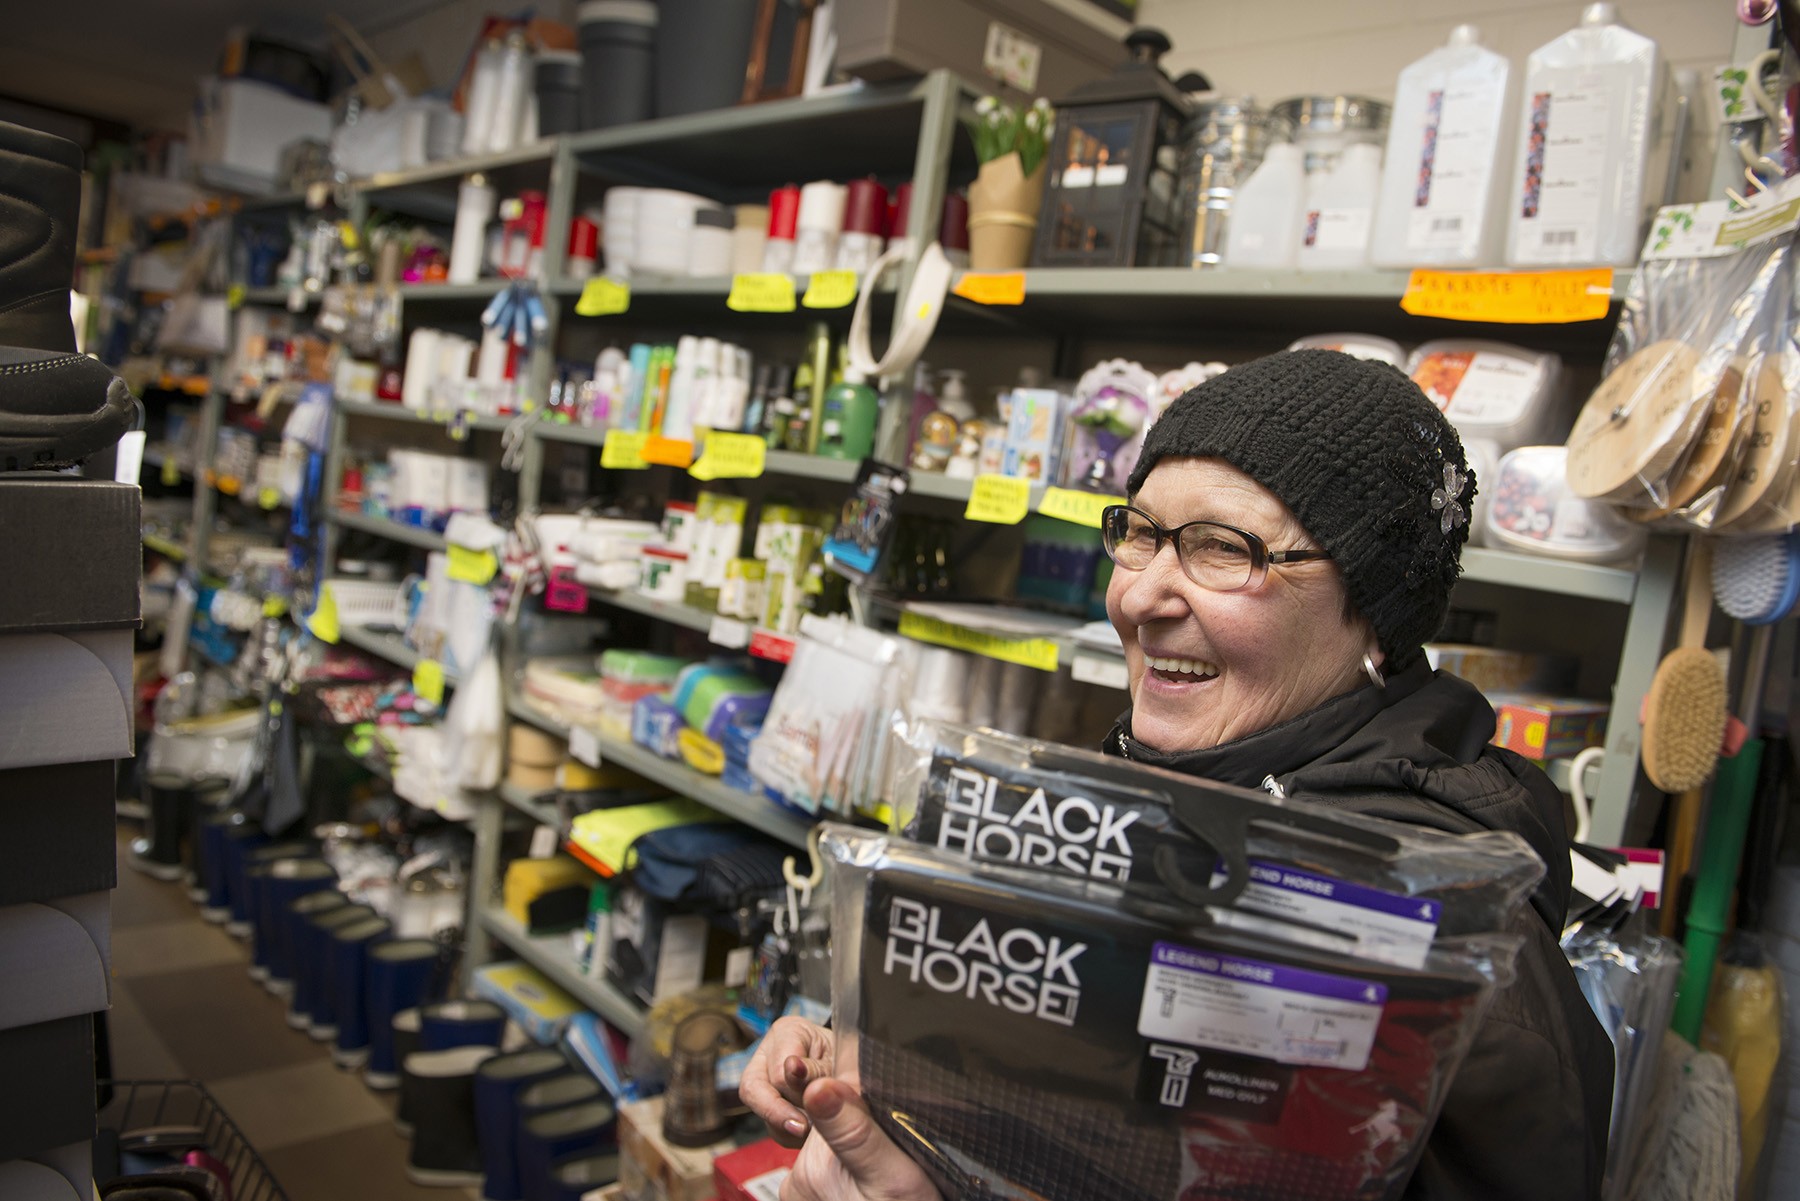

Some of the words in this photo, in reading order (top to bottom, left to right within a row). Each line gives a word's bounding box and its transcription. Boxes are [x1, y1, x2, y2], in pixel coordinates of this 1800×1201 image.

[937, 812, 1133, 883] HORSE
[944, 766, 1141, 857] BLACK
[1282, 872, 1335, 897] HORSE
[883, 936, 1081, 1027] HORSE
[888, 896, 1088, 988] BLACK
[1157, 947, 1219, 972] LEGEND
[1221, 961, 1275, 984] HORSE
